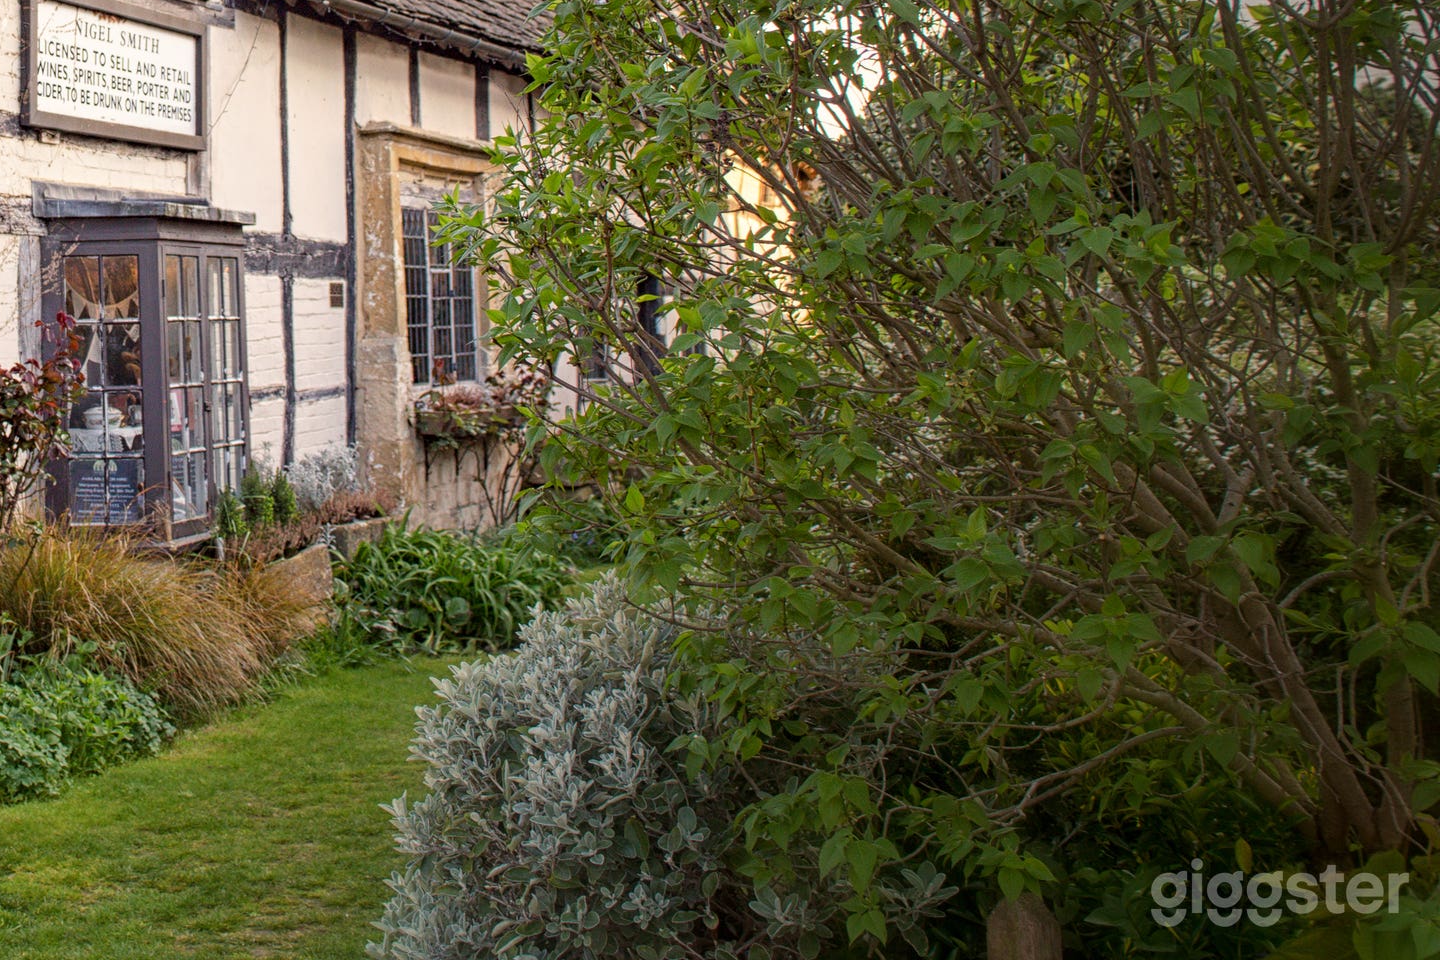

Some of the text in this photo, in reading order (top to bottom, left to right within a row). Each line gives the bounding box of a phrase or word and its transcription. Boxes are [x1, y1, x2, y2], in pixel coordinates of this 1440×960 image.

[75, 18, 160, 54] NIGEL SMITH
[37, 60, 192, 104] WINES, SPIRITS, BEER, PORTER AND
[38, 38, 191, 86] LICENSED TO SELL AND RETAIL
[36, 81, 192, 122] CIDER, TO BE DRUNK ON THE PREMISES
